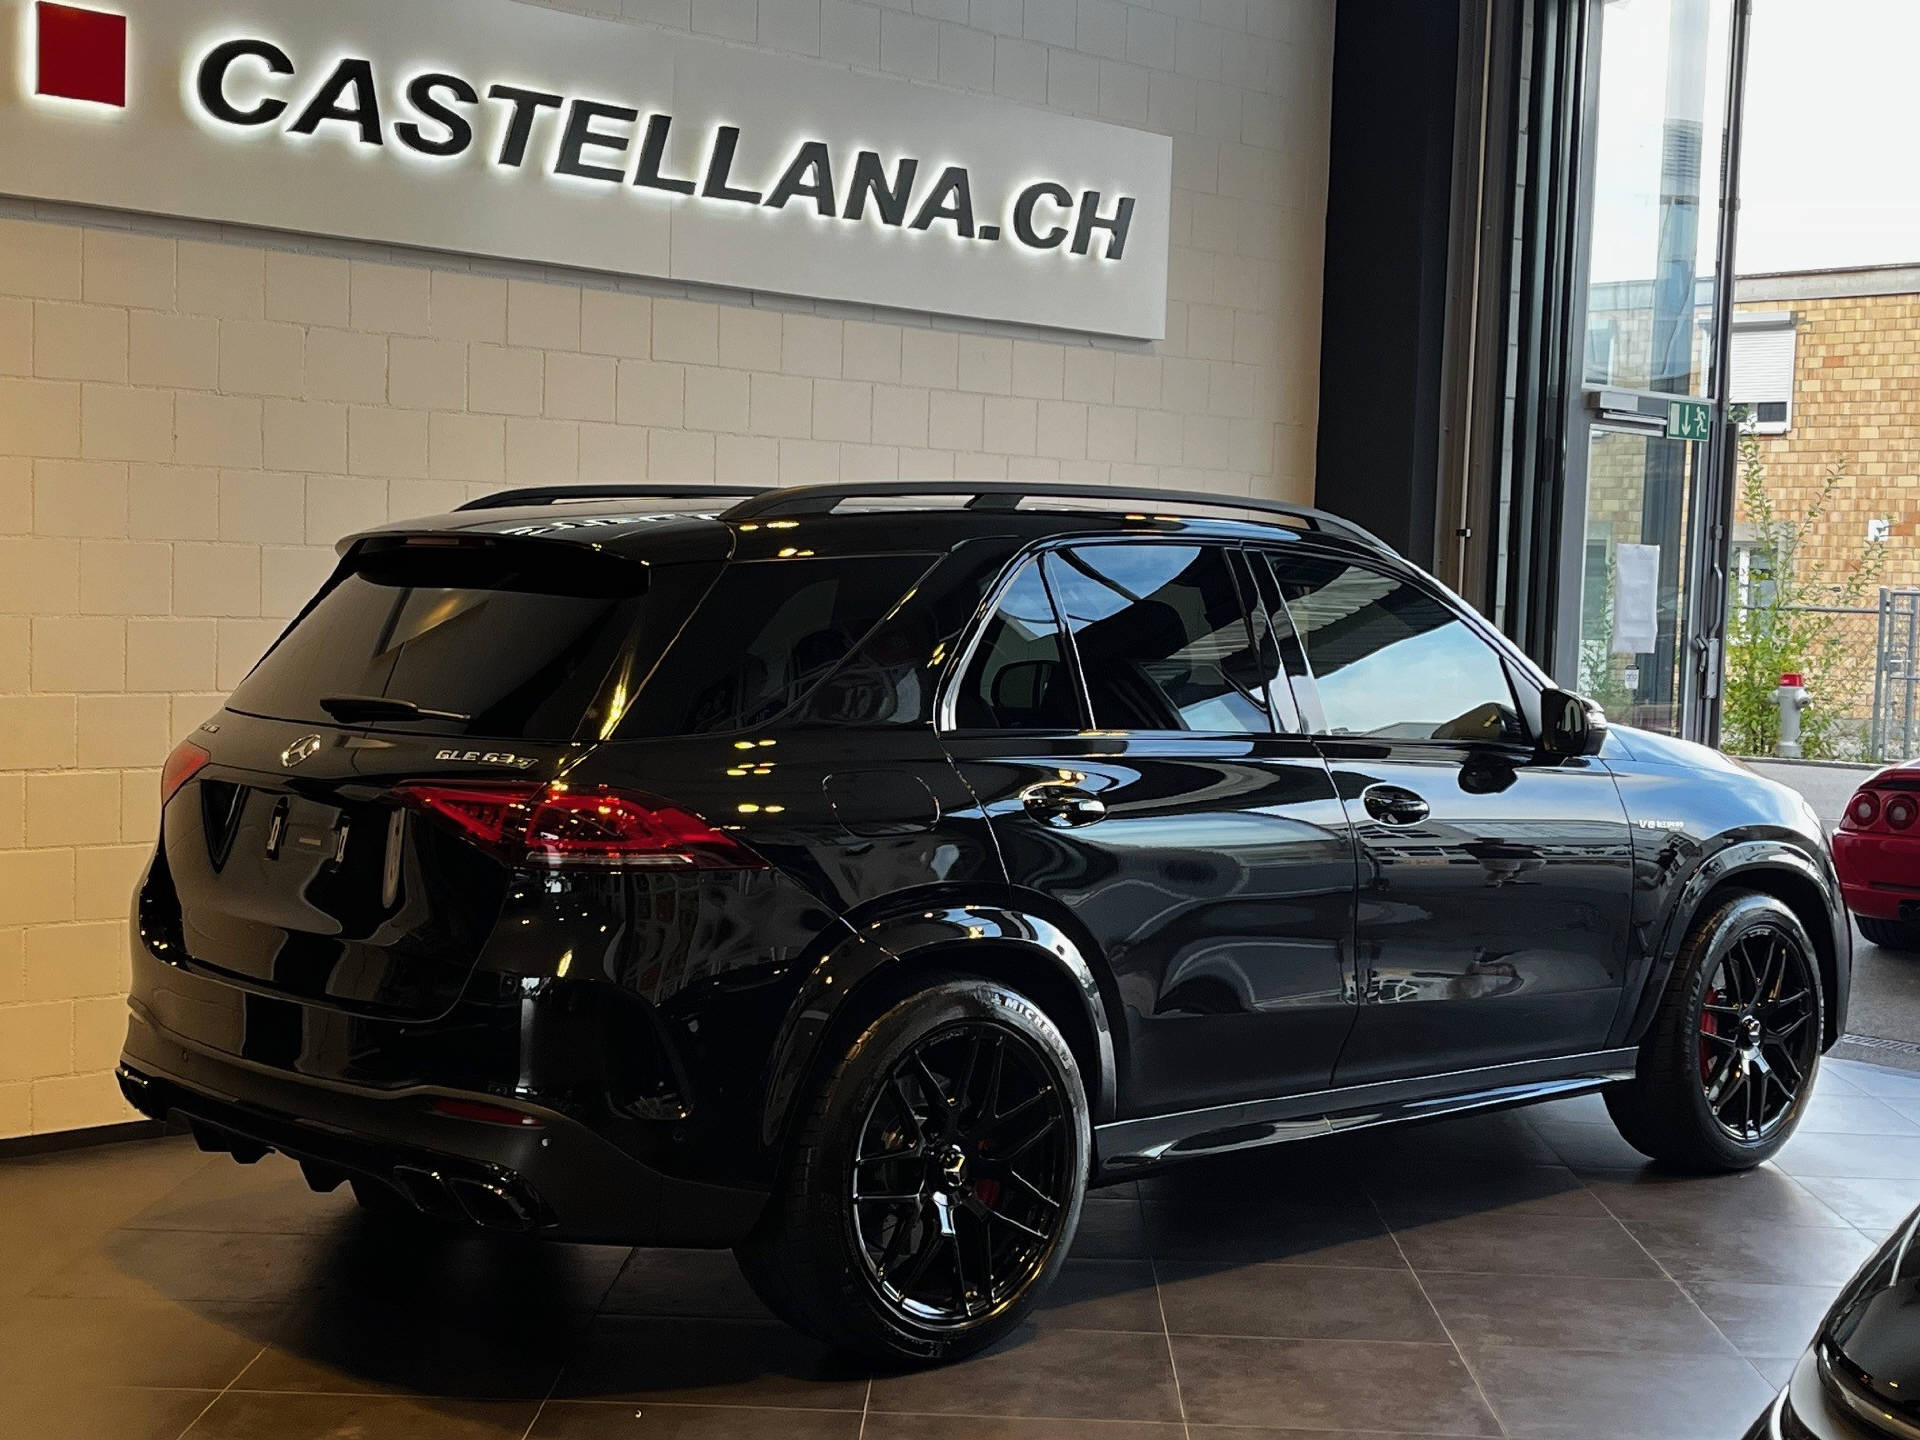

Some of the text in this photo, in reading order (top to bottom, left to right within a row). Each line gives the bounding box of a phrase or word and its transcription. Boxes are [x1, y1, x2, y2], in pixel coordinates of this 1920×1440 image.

[196, 37, 1136, 260] CASTELLANA.CH
[435, 749, 480, 761] GLE
[1003, 997, 1074, 1071] MICHEN
